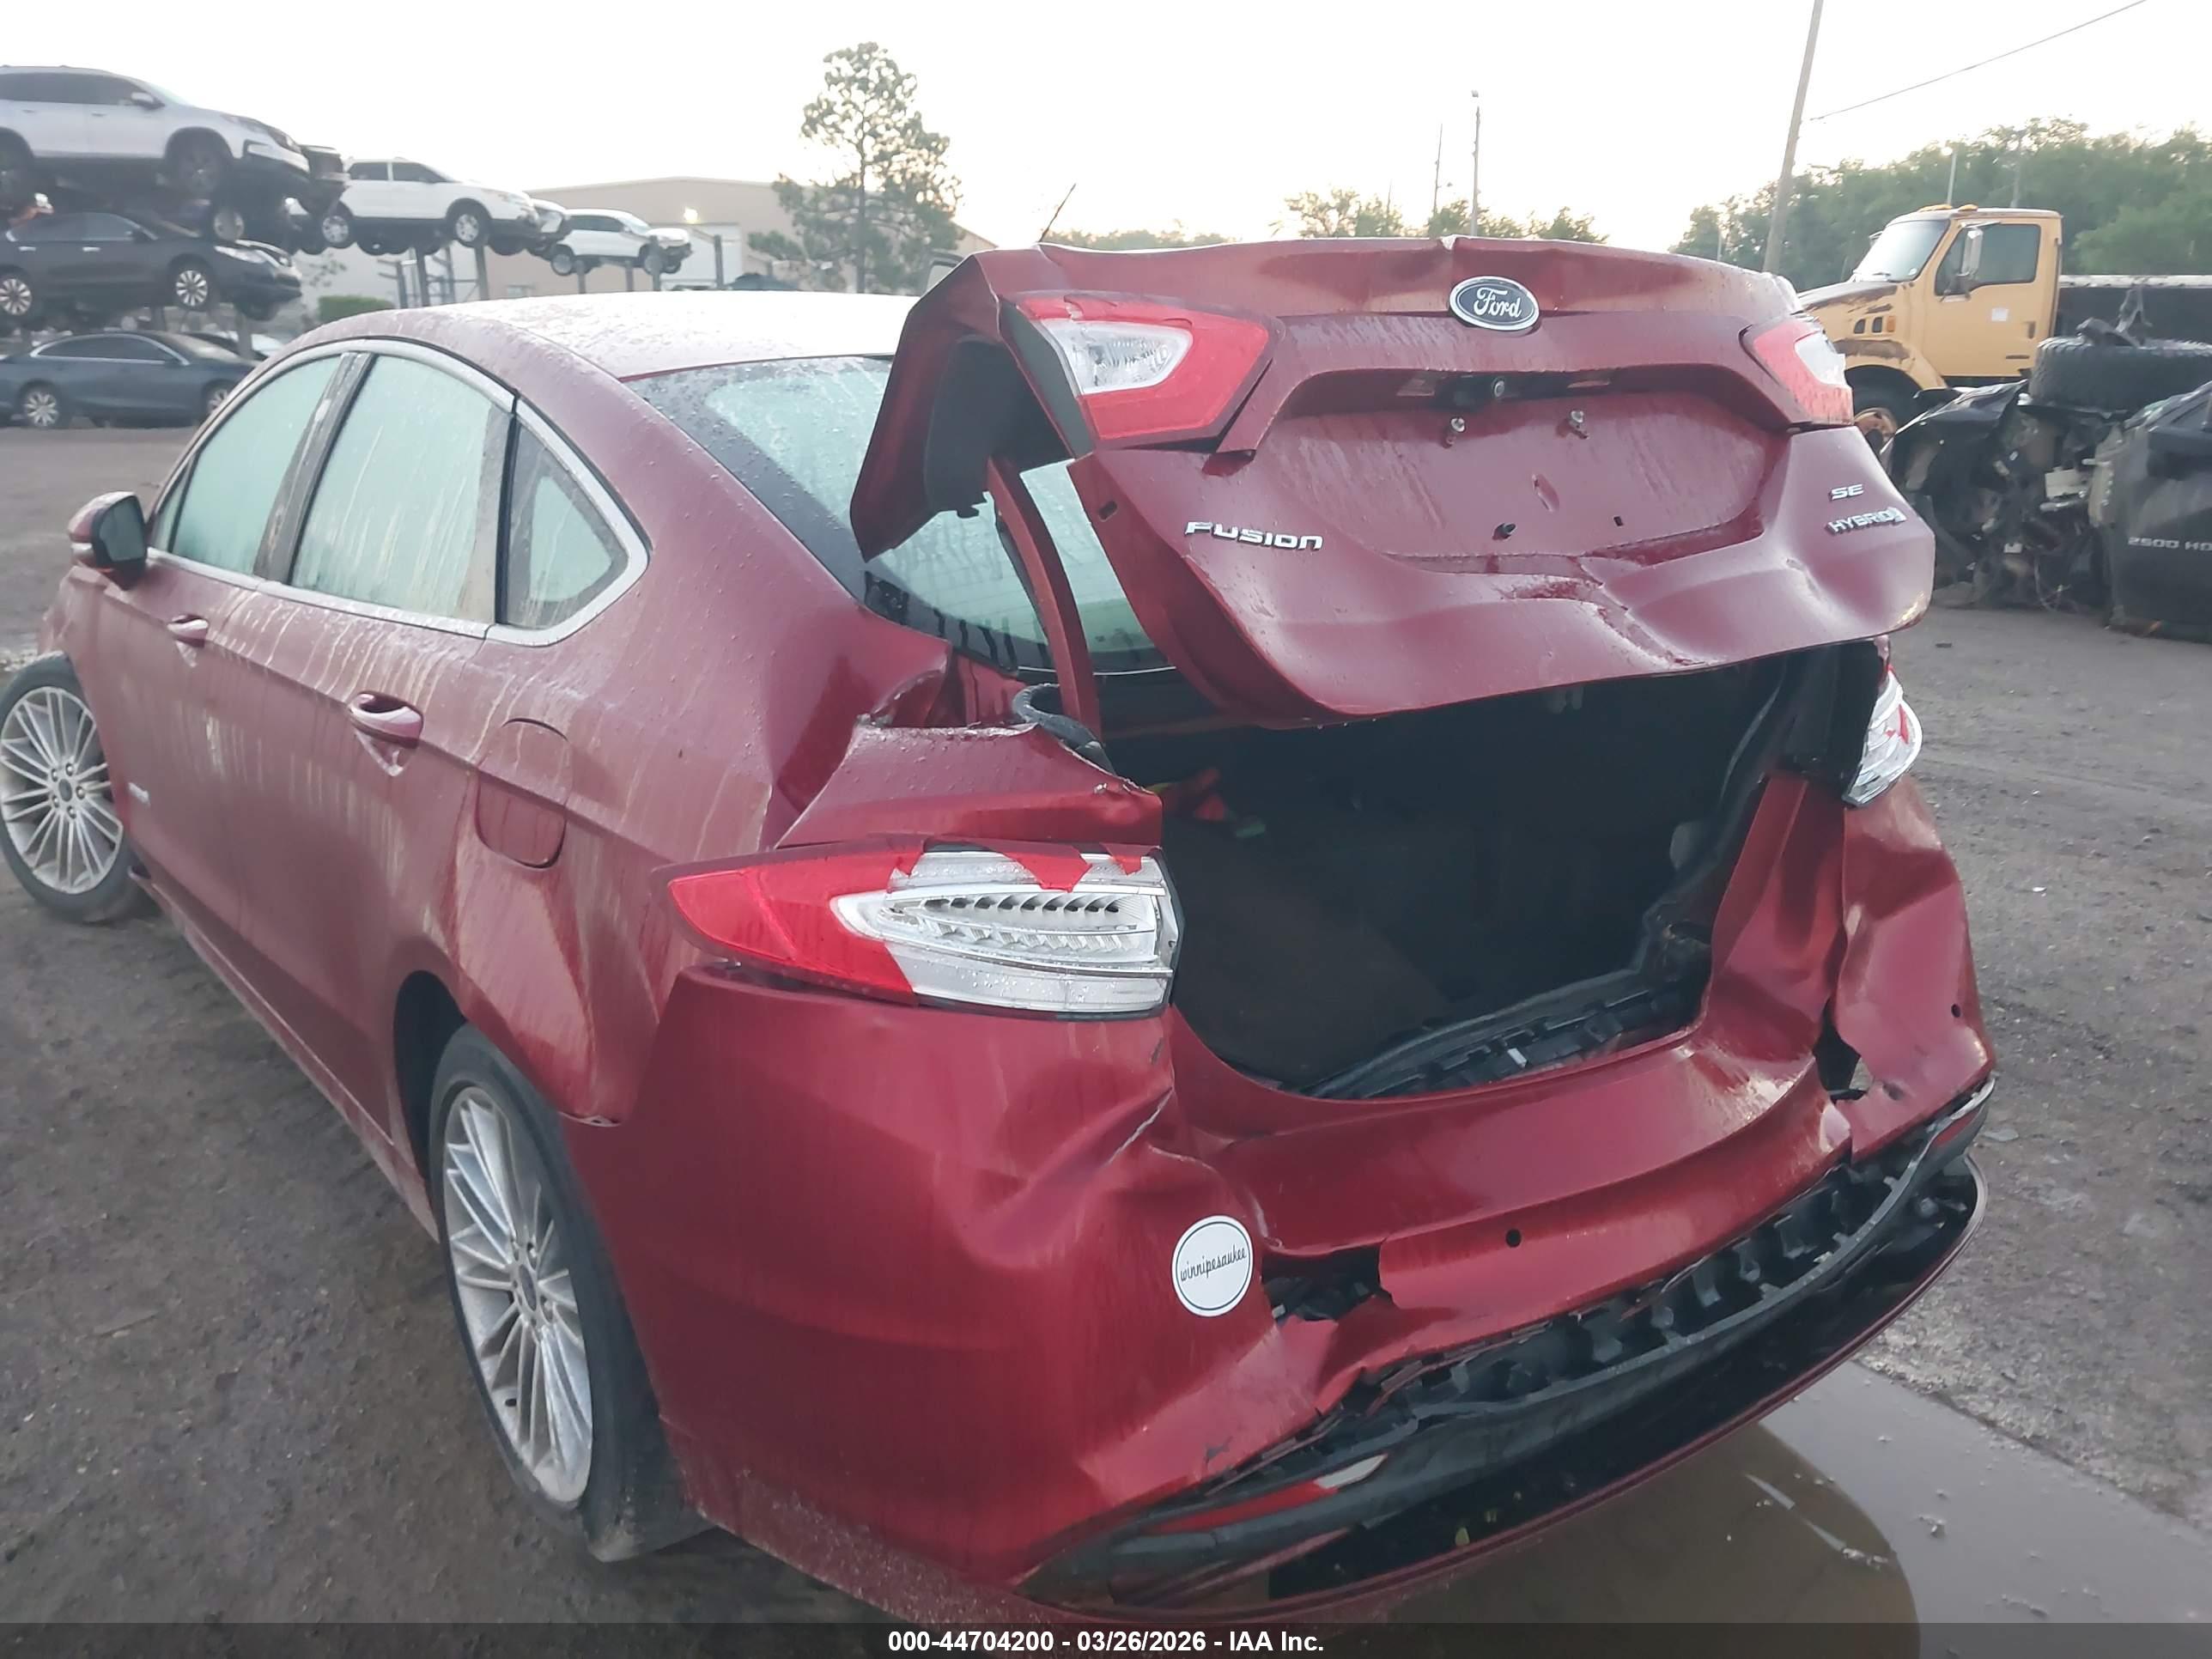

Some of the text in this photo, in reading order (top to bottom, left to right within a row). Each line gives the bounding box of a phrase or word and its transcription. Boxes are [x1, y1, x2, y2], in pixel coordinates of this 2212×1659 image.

[1474, 287, 1522, 318] Ford
[1831, 483, 1864, 501] SE
[1826, 510, 1895, 533] HYBRID
[1184, 521, 1323, 550] FUSION
[2128, 537, 2212, 551] 2500 HD
[1180, 1243, 1247, 1282] winnipesaukee
